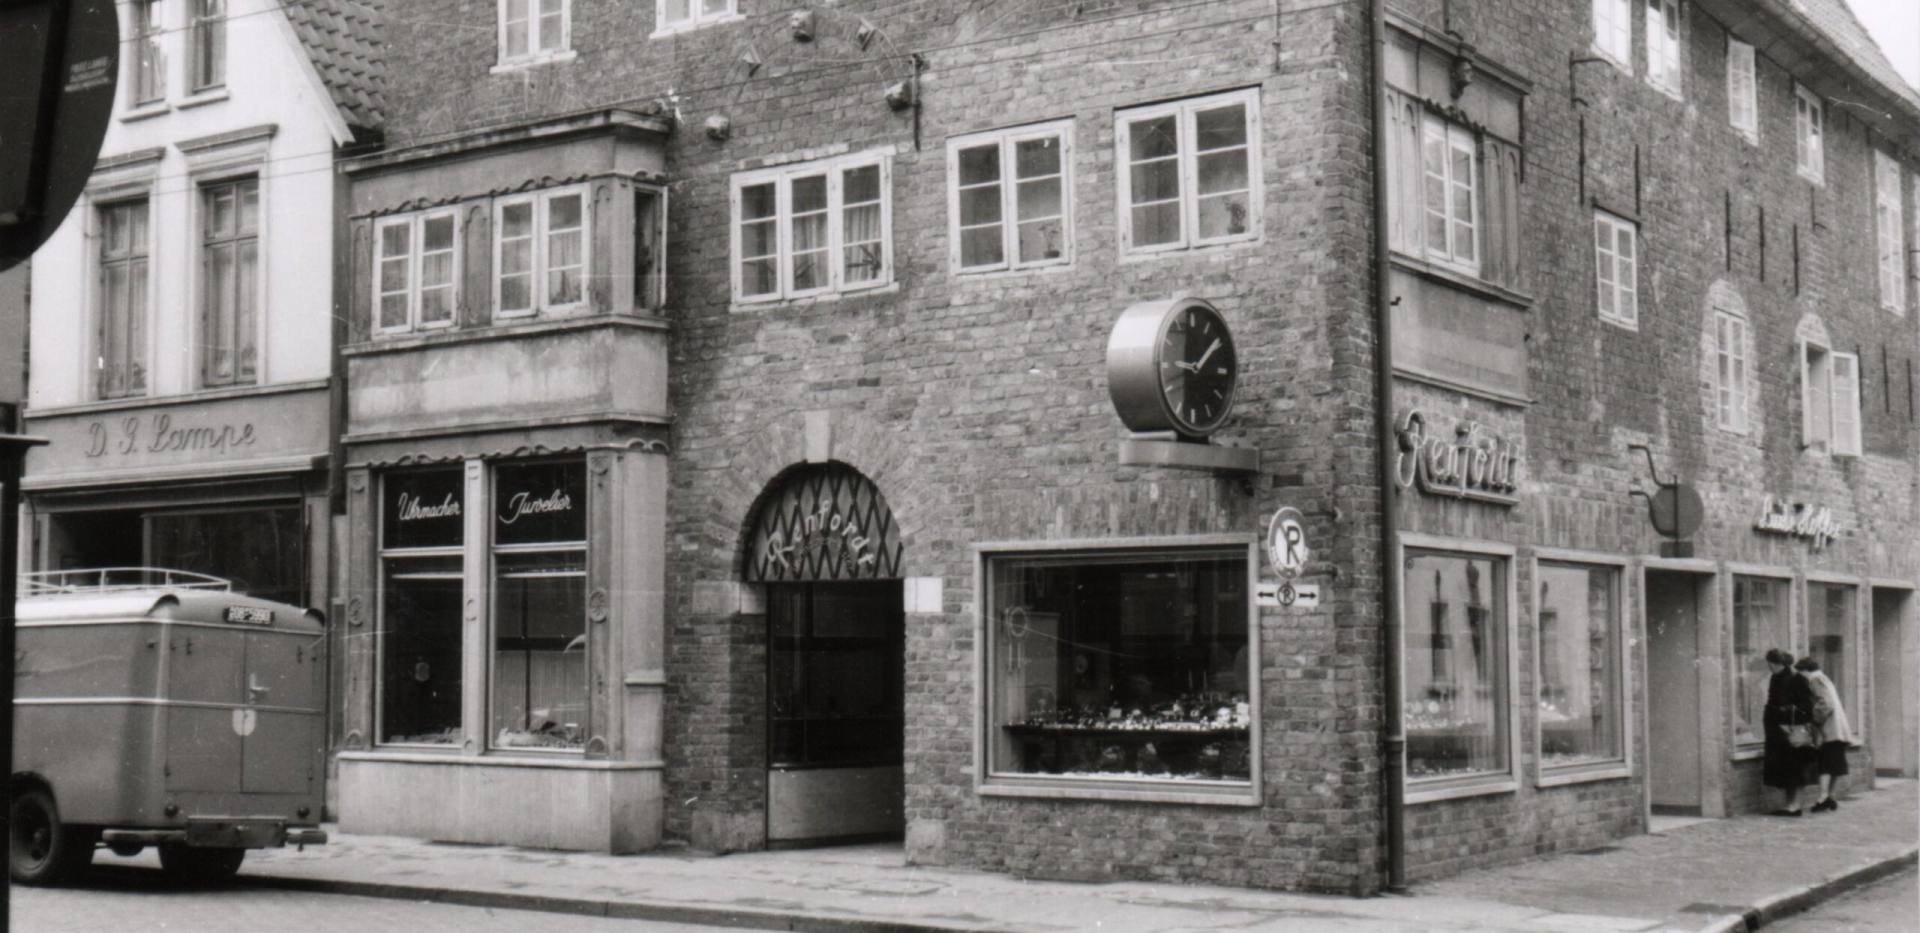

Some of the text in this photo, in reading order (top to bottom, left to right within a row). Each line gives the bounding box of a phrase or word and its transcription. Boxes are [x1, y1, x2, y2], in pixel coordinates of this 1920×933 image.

[147, 412, 257, 454] Lampe
[398, 492, 462, 521] Uhrmacher
[766, 499, 874, 571] Renfordt
